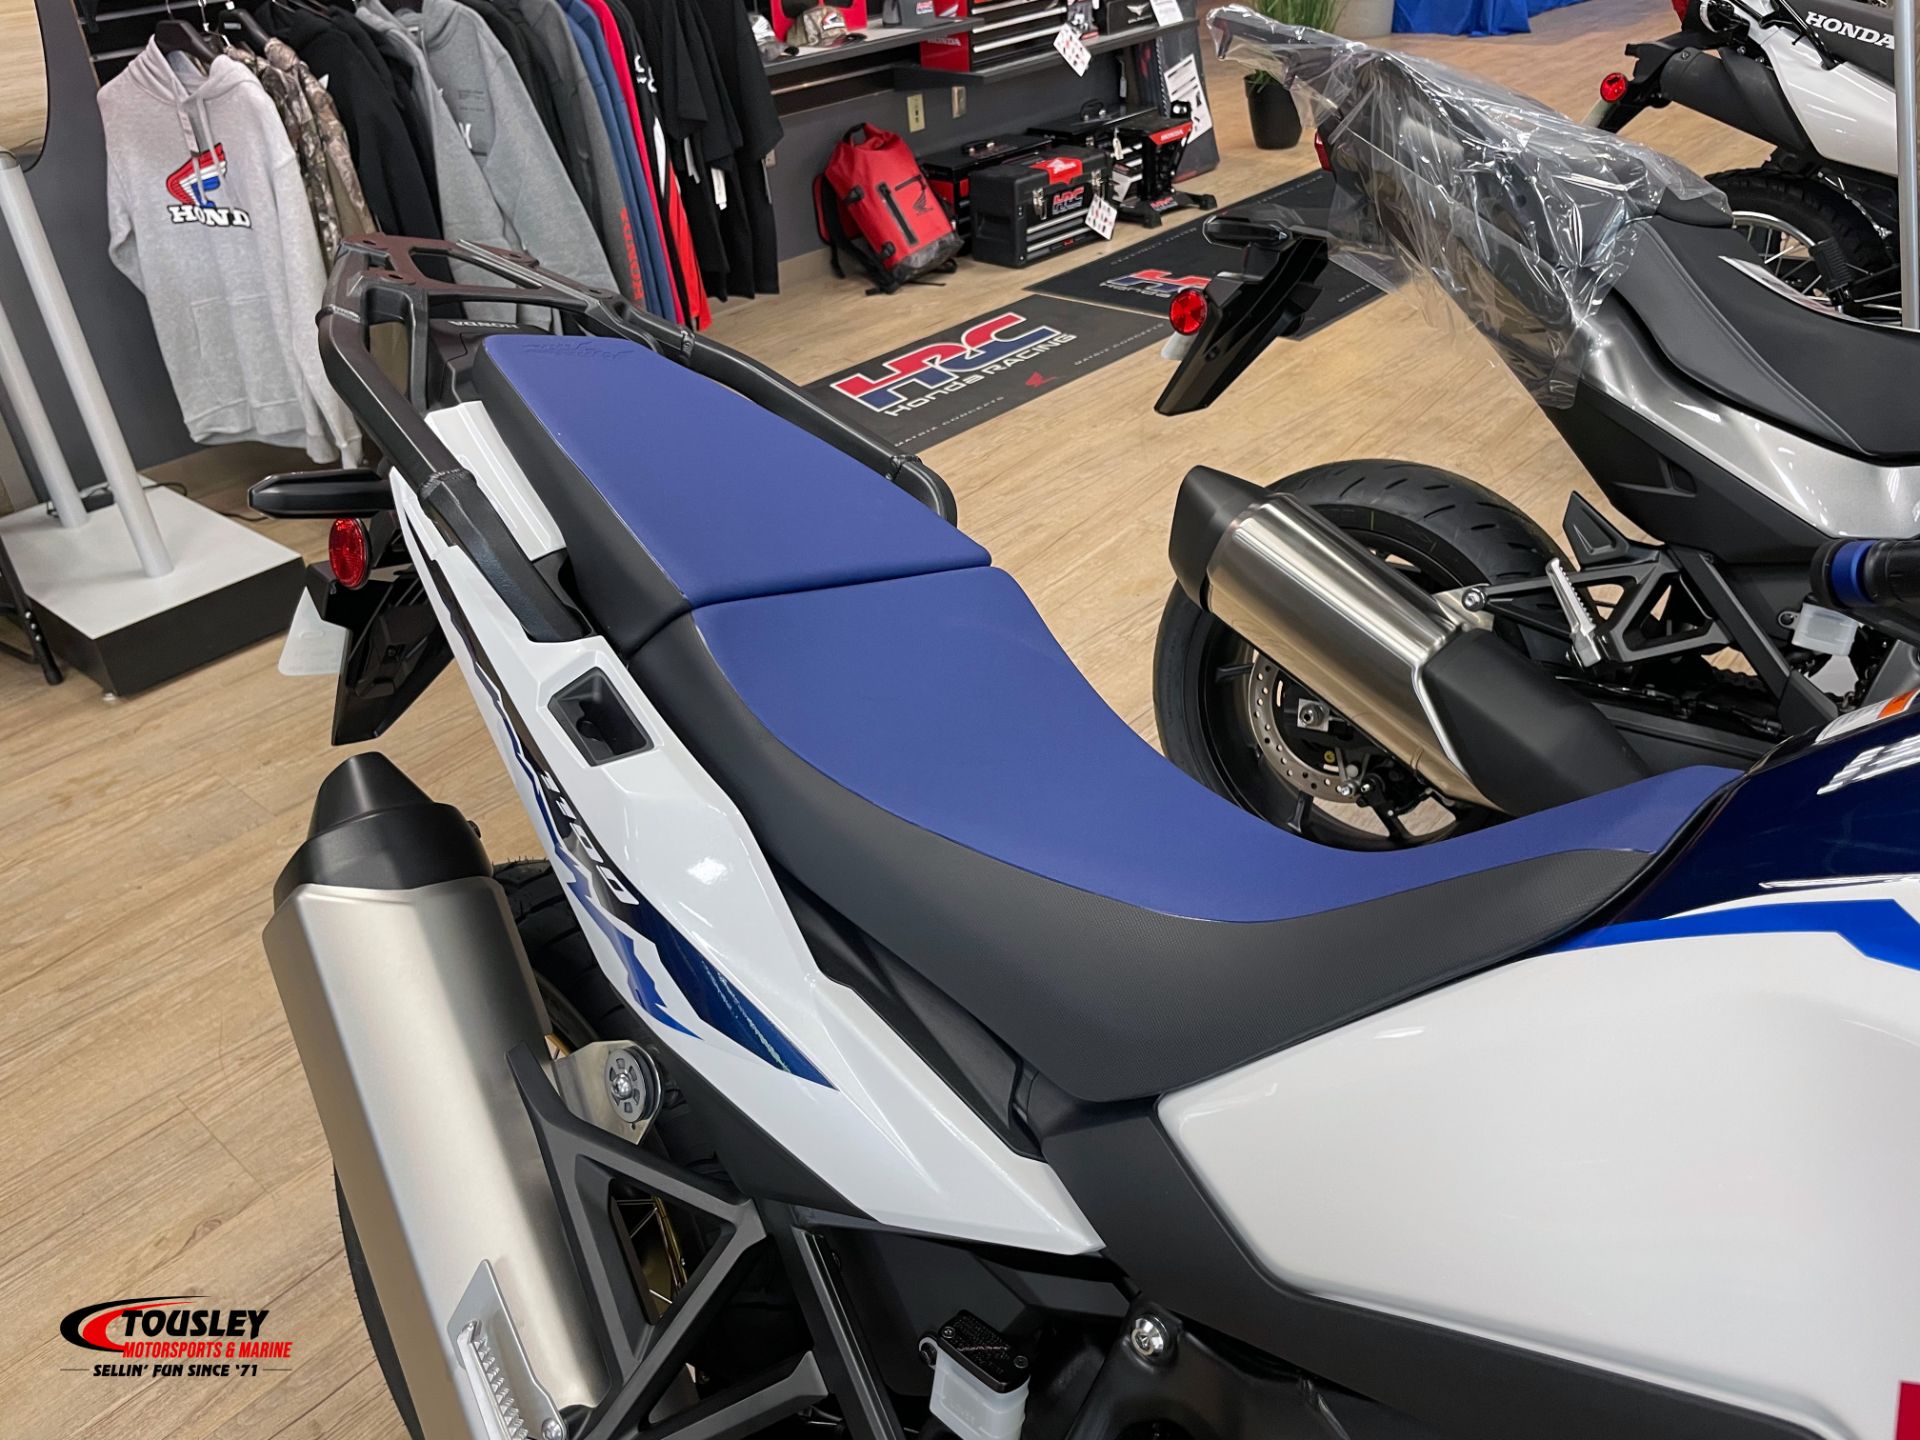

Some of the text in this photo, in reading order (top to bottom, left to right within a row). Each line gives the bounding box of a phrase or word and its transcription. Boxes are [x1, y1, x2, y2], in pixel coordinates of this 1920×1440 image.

[1805, 11, 1894, 49] HONDA
[167, 204, 252, 229] HOND
[829, 311, 1062, 413] HRC
[883, 332, 1077, 417] Honda RACING
